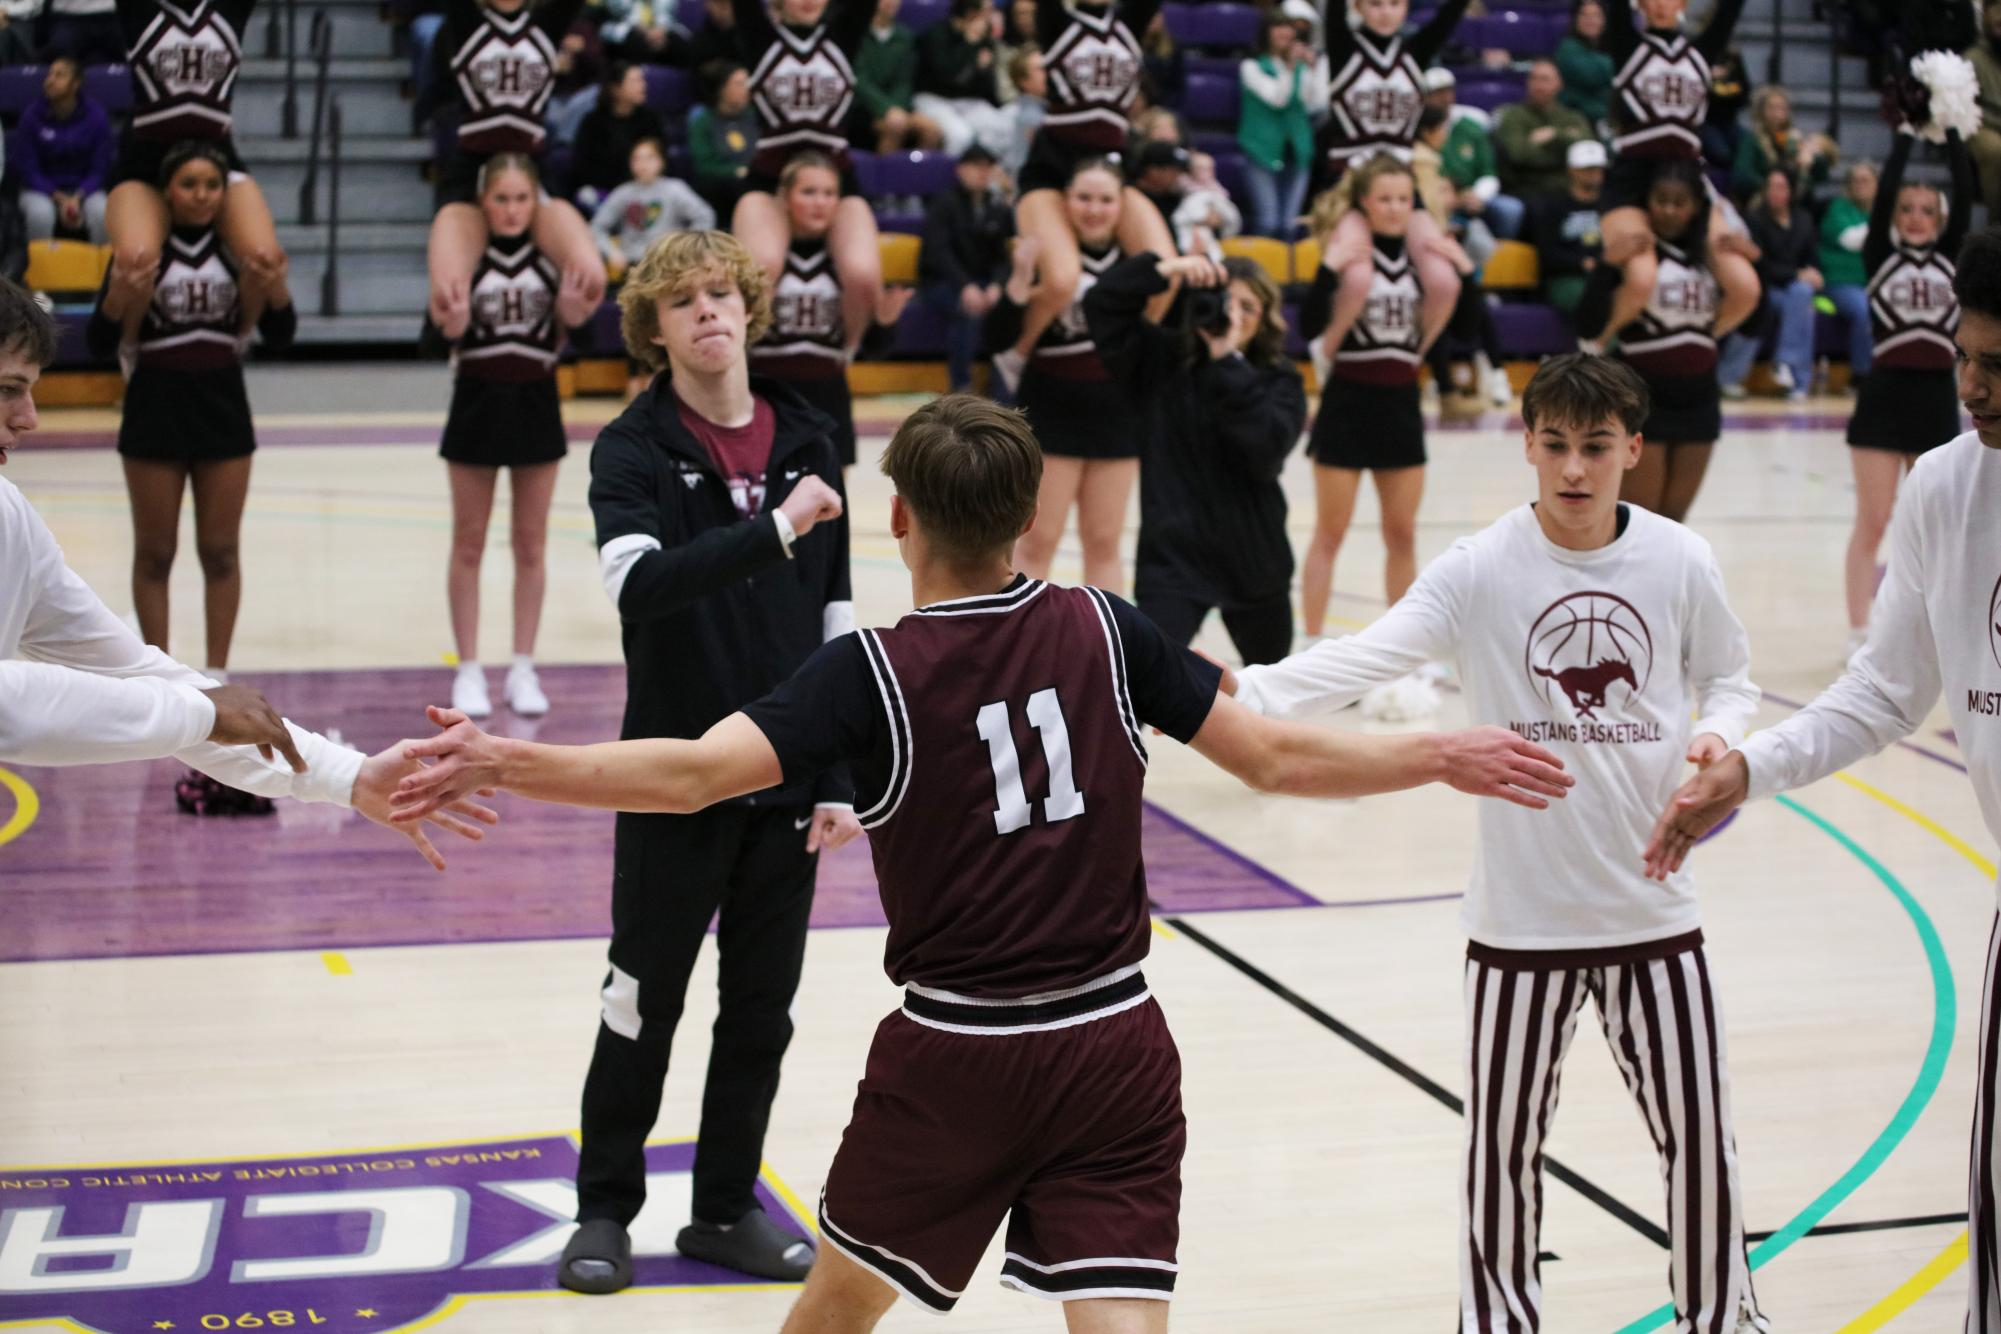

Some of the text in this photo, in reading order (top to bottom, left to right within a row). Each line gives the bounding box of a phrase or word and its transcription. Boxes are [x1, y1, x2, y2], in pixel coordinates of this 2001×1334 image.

[154, 43, 231, 85] CHS
[473, 57, 550, 94] CHS
[1068, 54, 1141, 90] CHS
[769, 74, 844, 110] CHS
[1351, 87, 1422, 123] CHS
[1642, 73, 1708, 107] CHS
[162, 275, 236, 314] CHS
[475, 287, 551, 324] CHS
[1364, 295, 1419, 327] CH
[1890, 277, 1951, 311] CHS
[1510, 721, 1662, 743] MUSTANG BASKETBALL
[975, 686, 1085, 835] 11
[0, 1148, 542, 1189] KANSAS COLLEGIATE ATHLETIC CON
[200, 1308, 326, 1330] 1890
